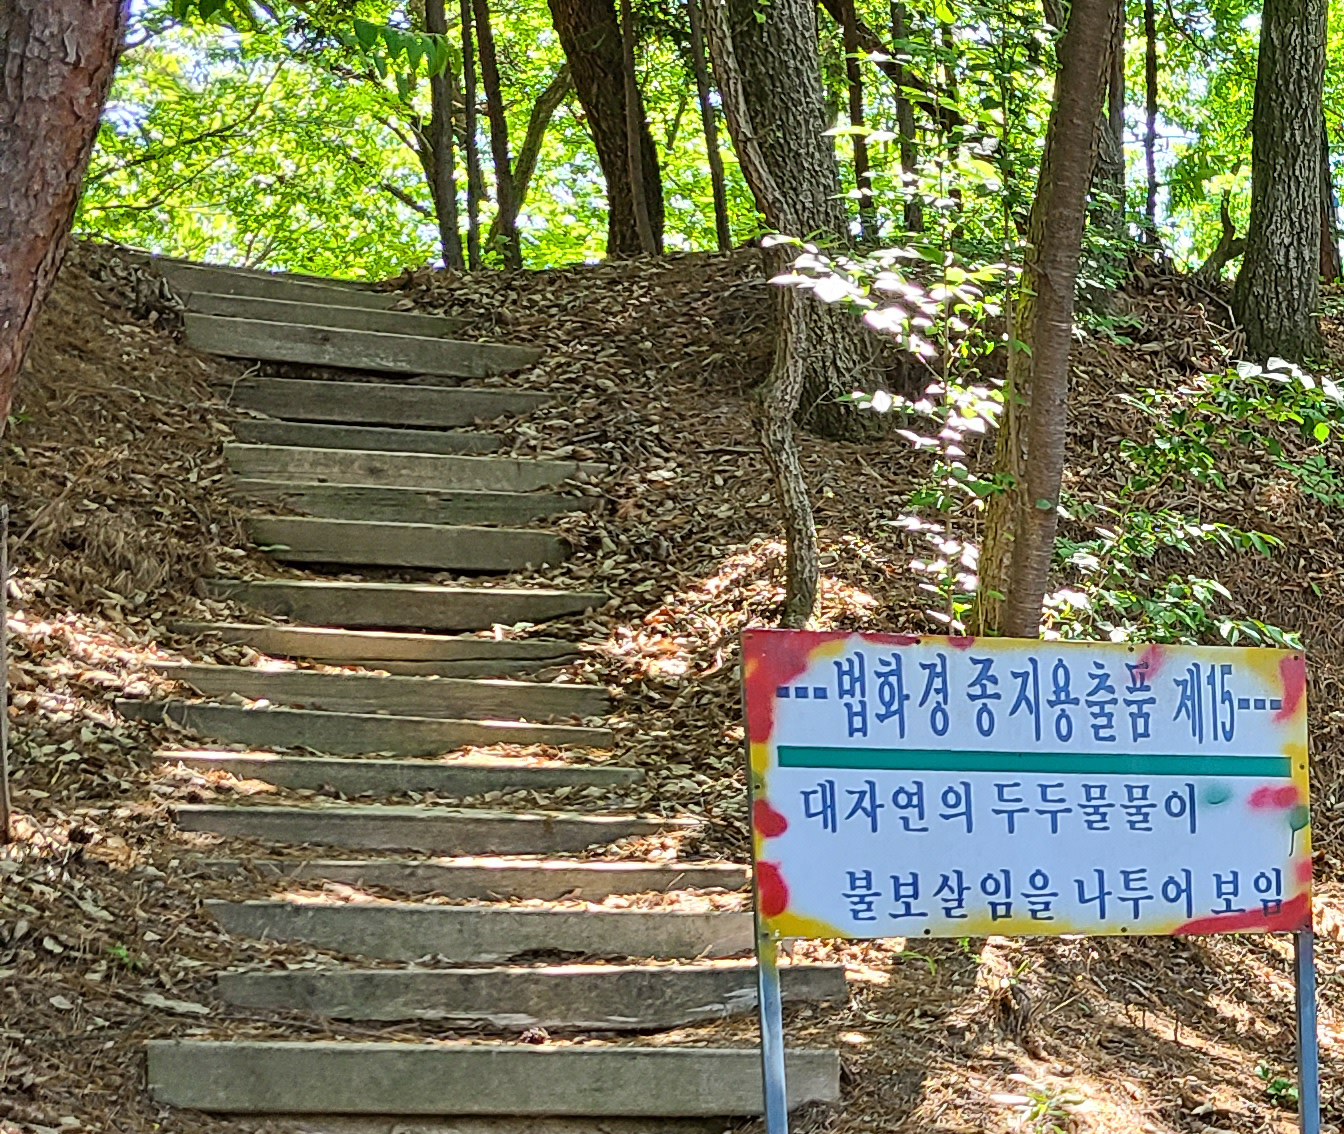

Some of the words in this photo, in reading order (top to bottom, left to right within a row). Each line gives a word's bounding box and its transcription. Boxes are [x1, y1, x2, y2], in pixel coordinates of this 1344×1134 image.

[967, 655, 1158, 744] 종지용출품
[800, 778, 974, 835] 대자연의
[990, 781, 1198, 835] 두두물물이
[842, 867, 1060, 921] 불보살임을
[1074, 867, 1195, 920] 나투어
[1210, 867, 1284, 918] 보임
